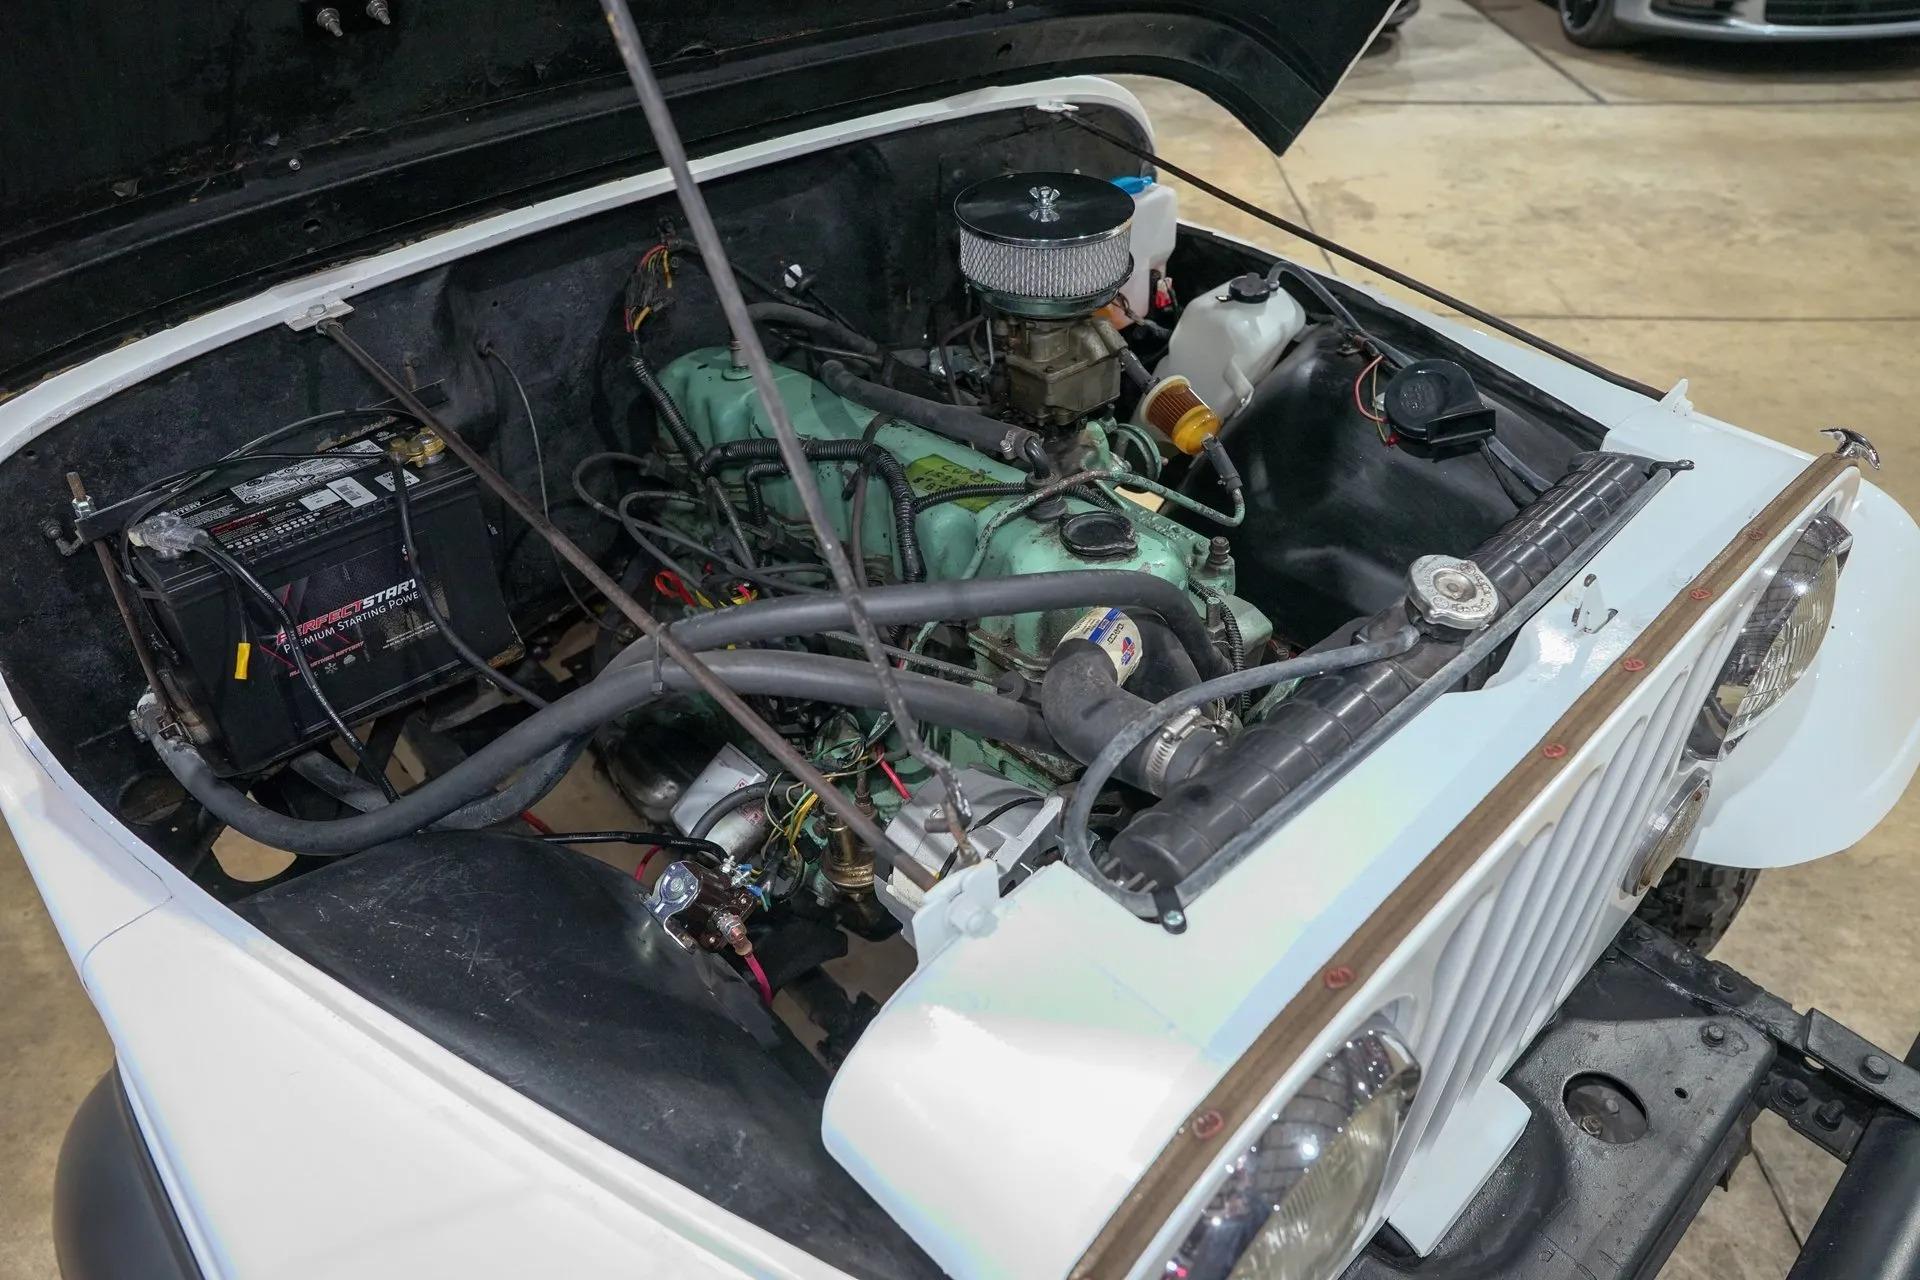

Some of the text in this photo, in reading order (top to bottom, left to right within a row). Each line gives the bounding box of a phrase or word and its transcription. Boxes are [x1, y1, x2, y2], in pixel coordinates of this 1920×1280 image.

[283, 590, 421, 655] PMIUM STARTING POWE
